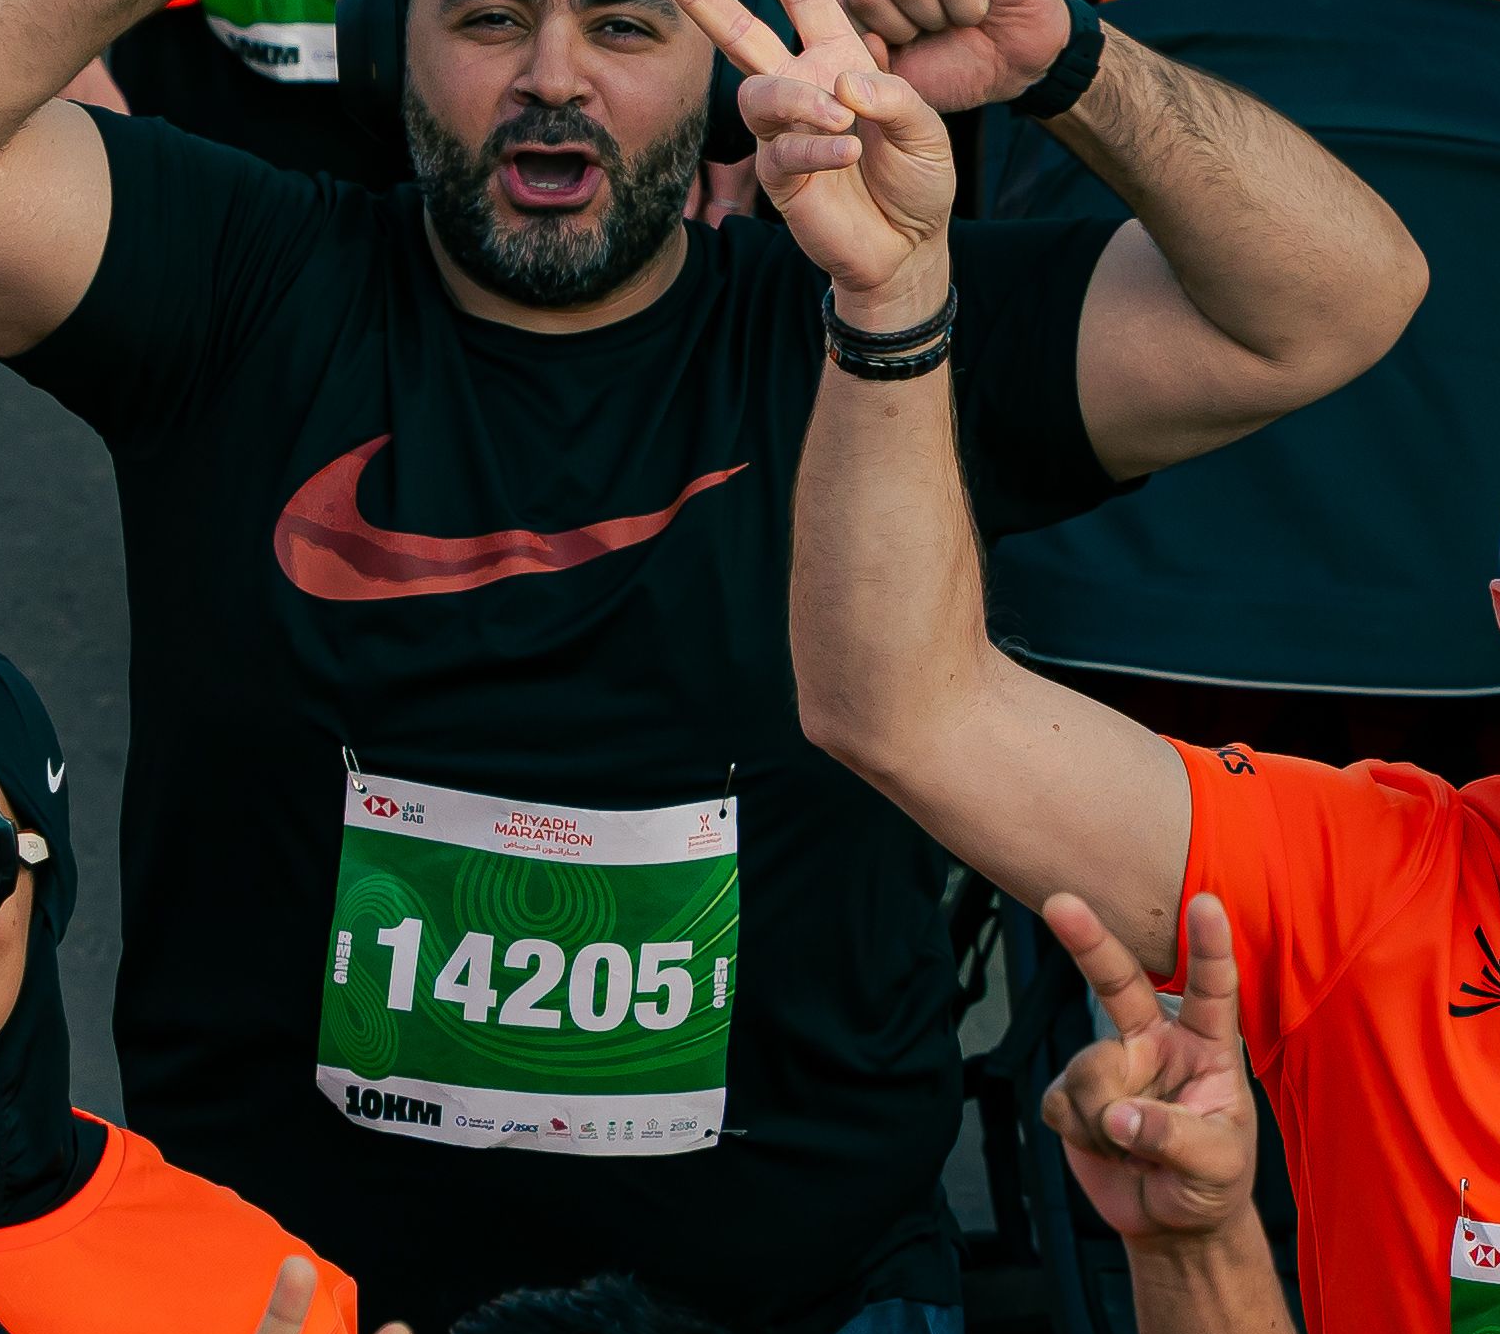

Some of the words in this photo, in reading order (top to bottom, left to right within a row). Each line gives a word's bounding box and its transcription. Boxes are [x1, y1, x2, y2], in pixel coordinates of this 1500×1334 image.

[401, 813, 426, 825] SAB
[510, 811, 578, 833] RIYADH
[494, 822, 594, 848] MARATHON
[377, 917, 696, 1033] 14205
[345, 1084, 444, 1128] 10KM
